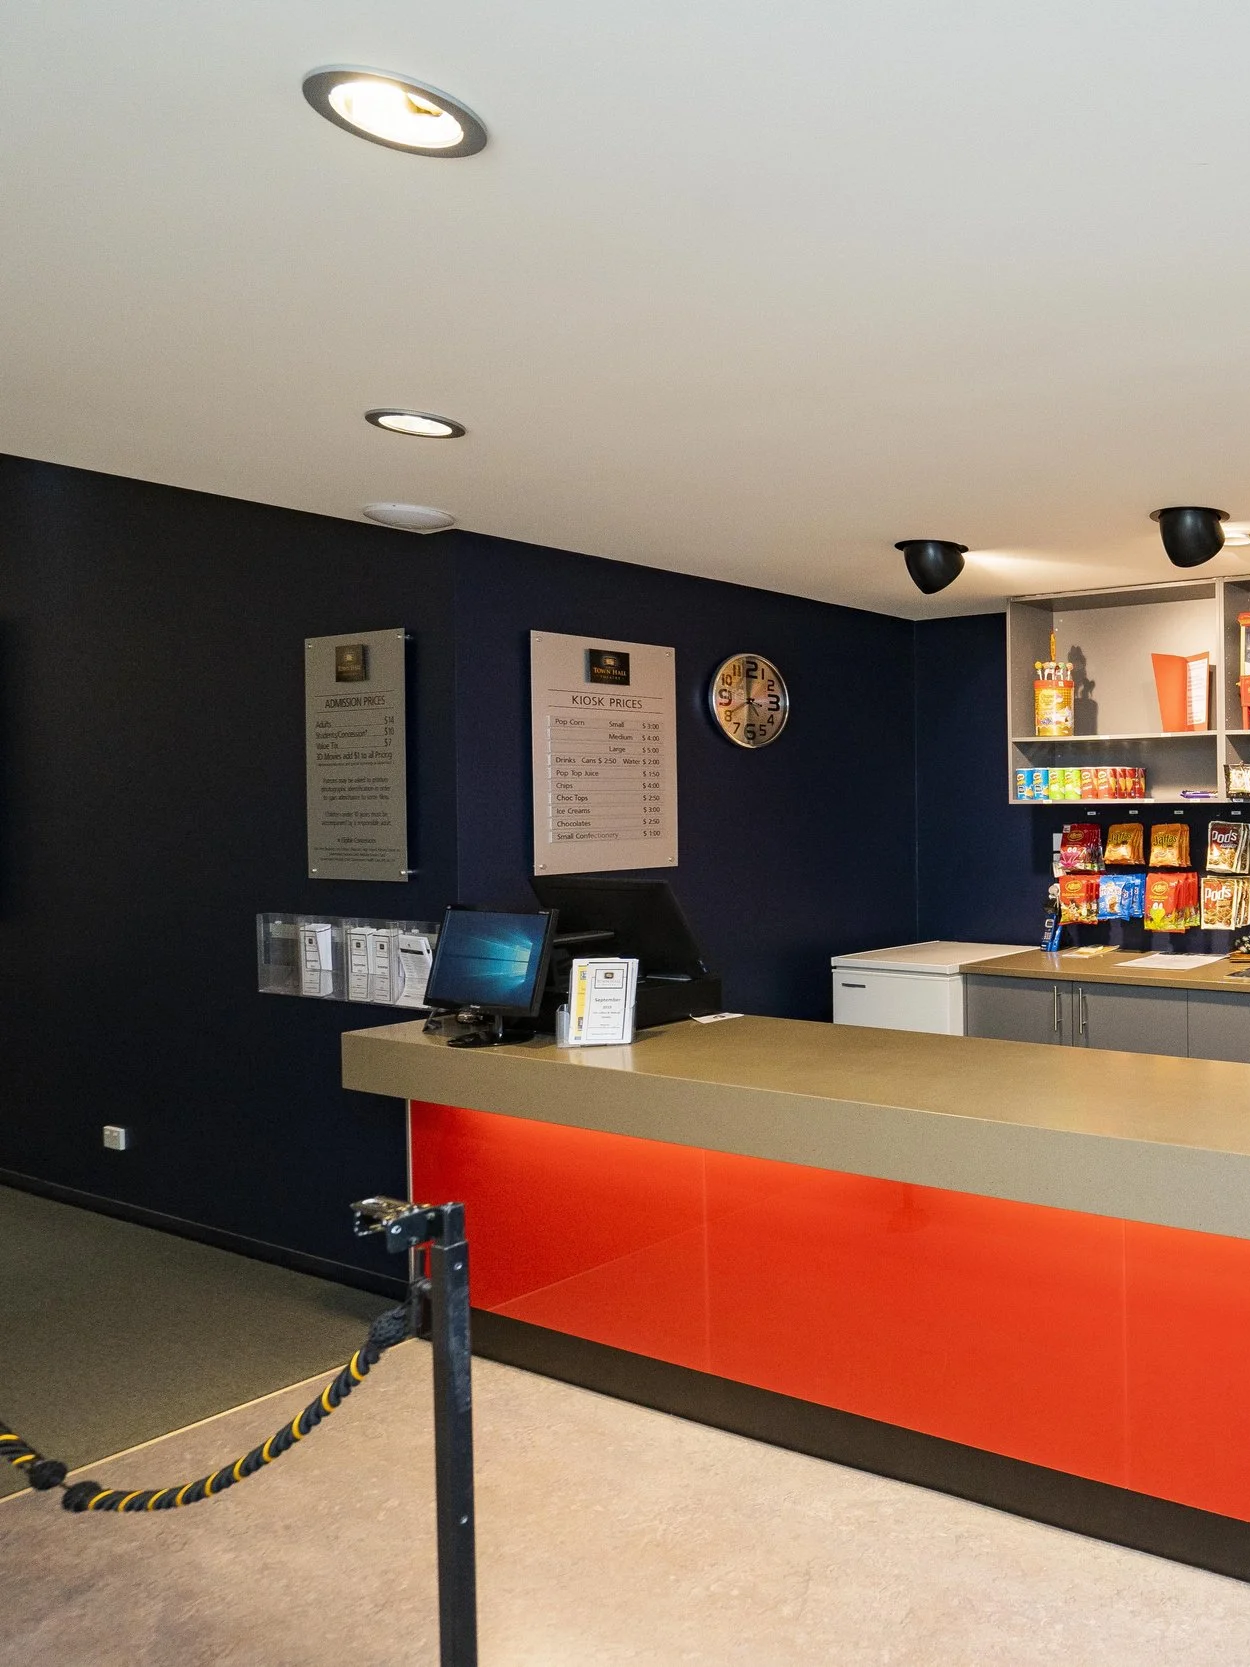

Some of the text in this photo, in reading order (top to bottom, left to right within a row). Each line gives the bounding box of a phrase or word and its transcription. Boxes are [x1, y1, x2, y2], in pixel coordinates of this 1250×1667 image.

[593, 667, 610, 675] TOWN
[732, 665, 741, 677] 11
[742, 661, 758, 679] 2
[721, 674, 732, 686] 10
[767, 680, 775, 691] 2
[325, 695, 385, 709] ADMISSION PRICES
[571, 695, 643, 709] KIOSK PRICES
[719, 689, 733, 706] 9
[767, 694, 780, 711] 3
[724, 710, 732, 722] 8
[767, 714, 774, 726] 4
[733, 722, 740, 734] 7
[744, 723, 756, 740] 6
[760, 724, 767, 736] 5
[574, 794, 588, 802] Tops
[1153, 834, 1178, 846] Jaffas
